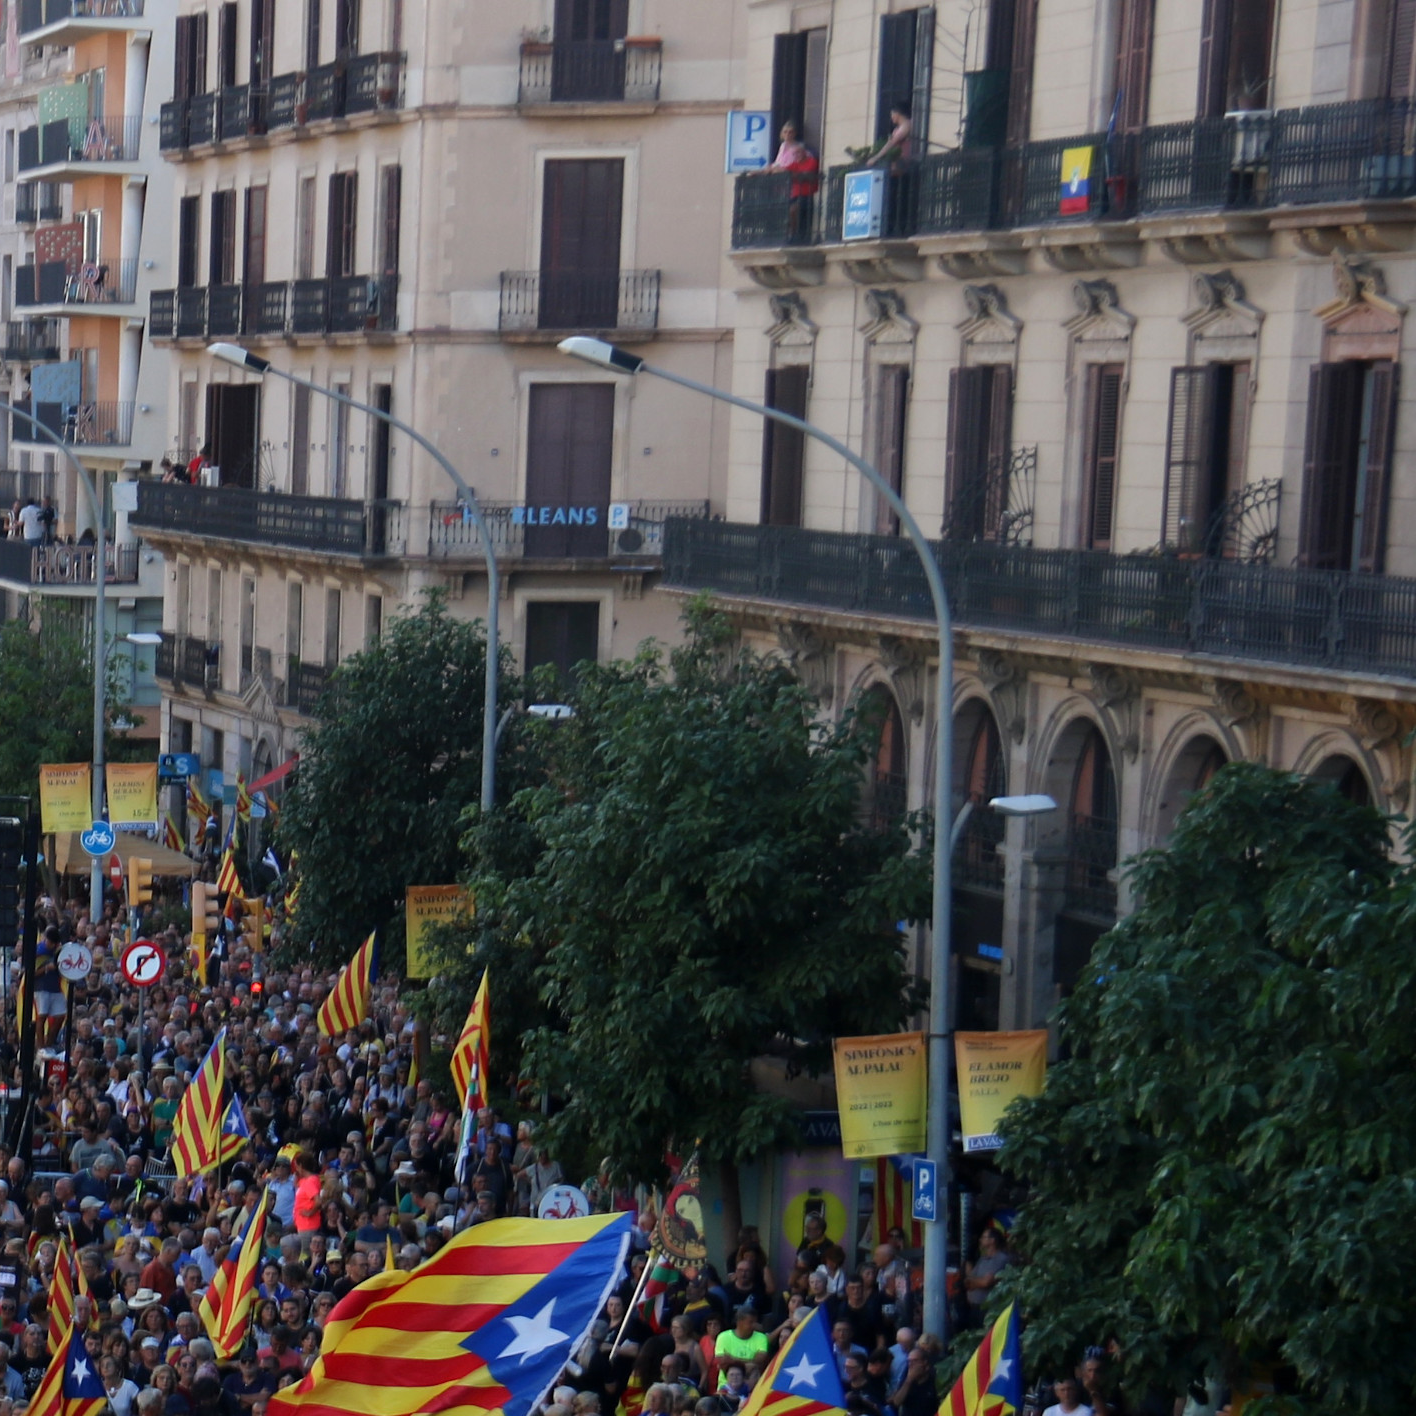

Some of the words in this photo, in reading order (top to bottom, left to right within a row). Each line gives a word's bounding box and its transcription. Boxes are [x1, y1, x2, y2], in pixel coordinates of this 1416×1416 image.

[743, 115, 766, 142] P
[31, 545, 136, 582] HOTEL
[987, 1060, 1022, 1072] AMOR
[970, 1074, 1009, 1085] BRUJO
[919, 1168, 929, 1190] P
